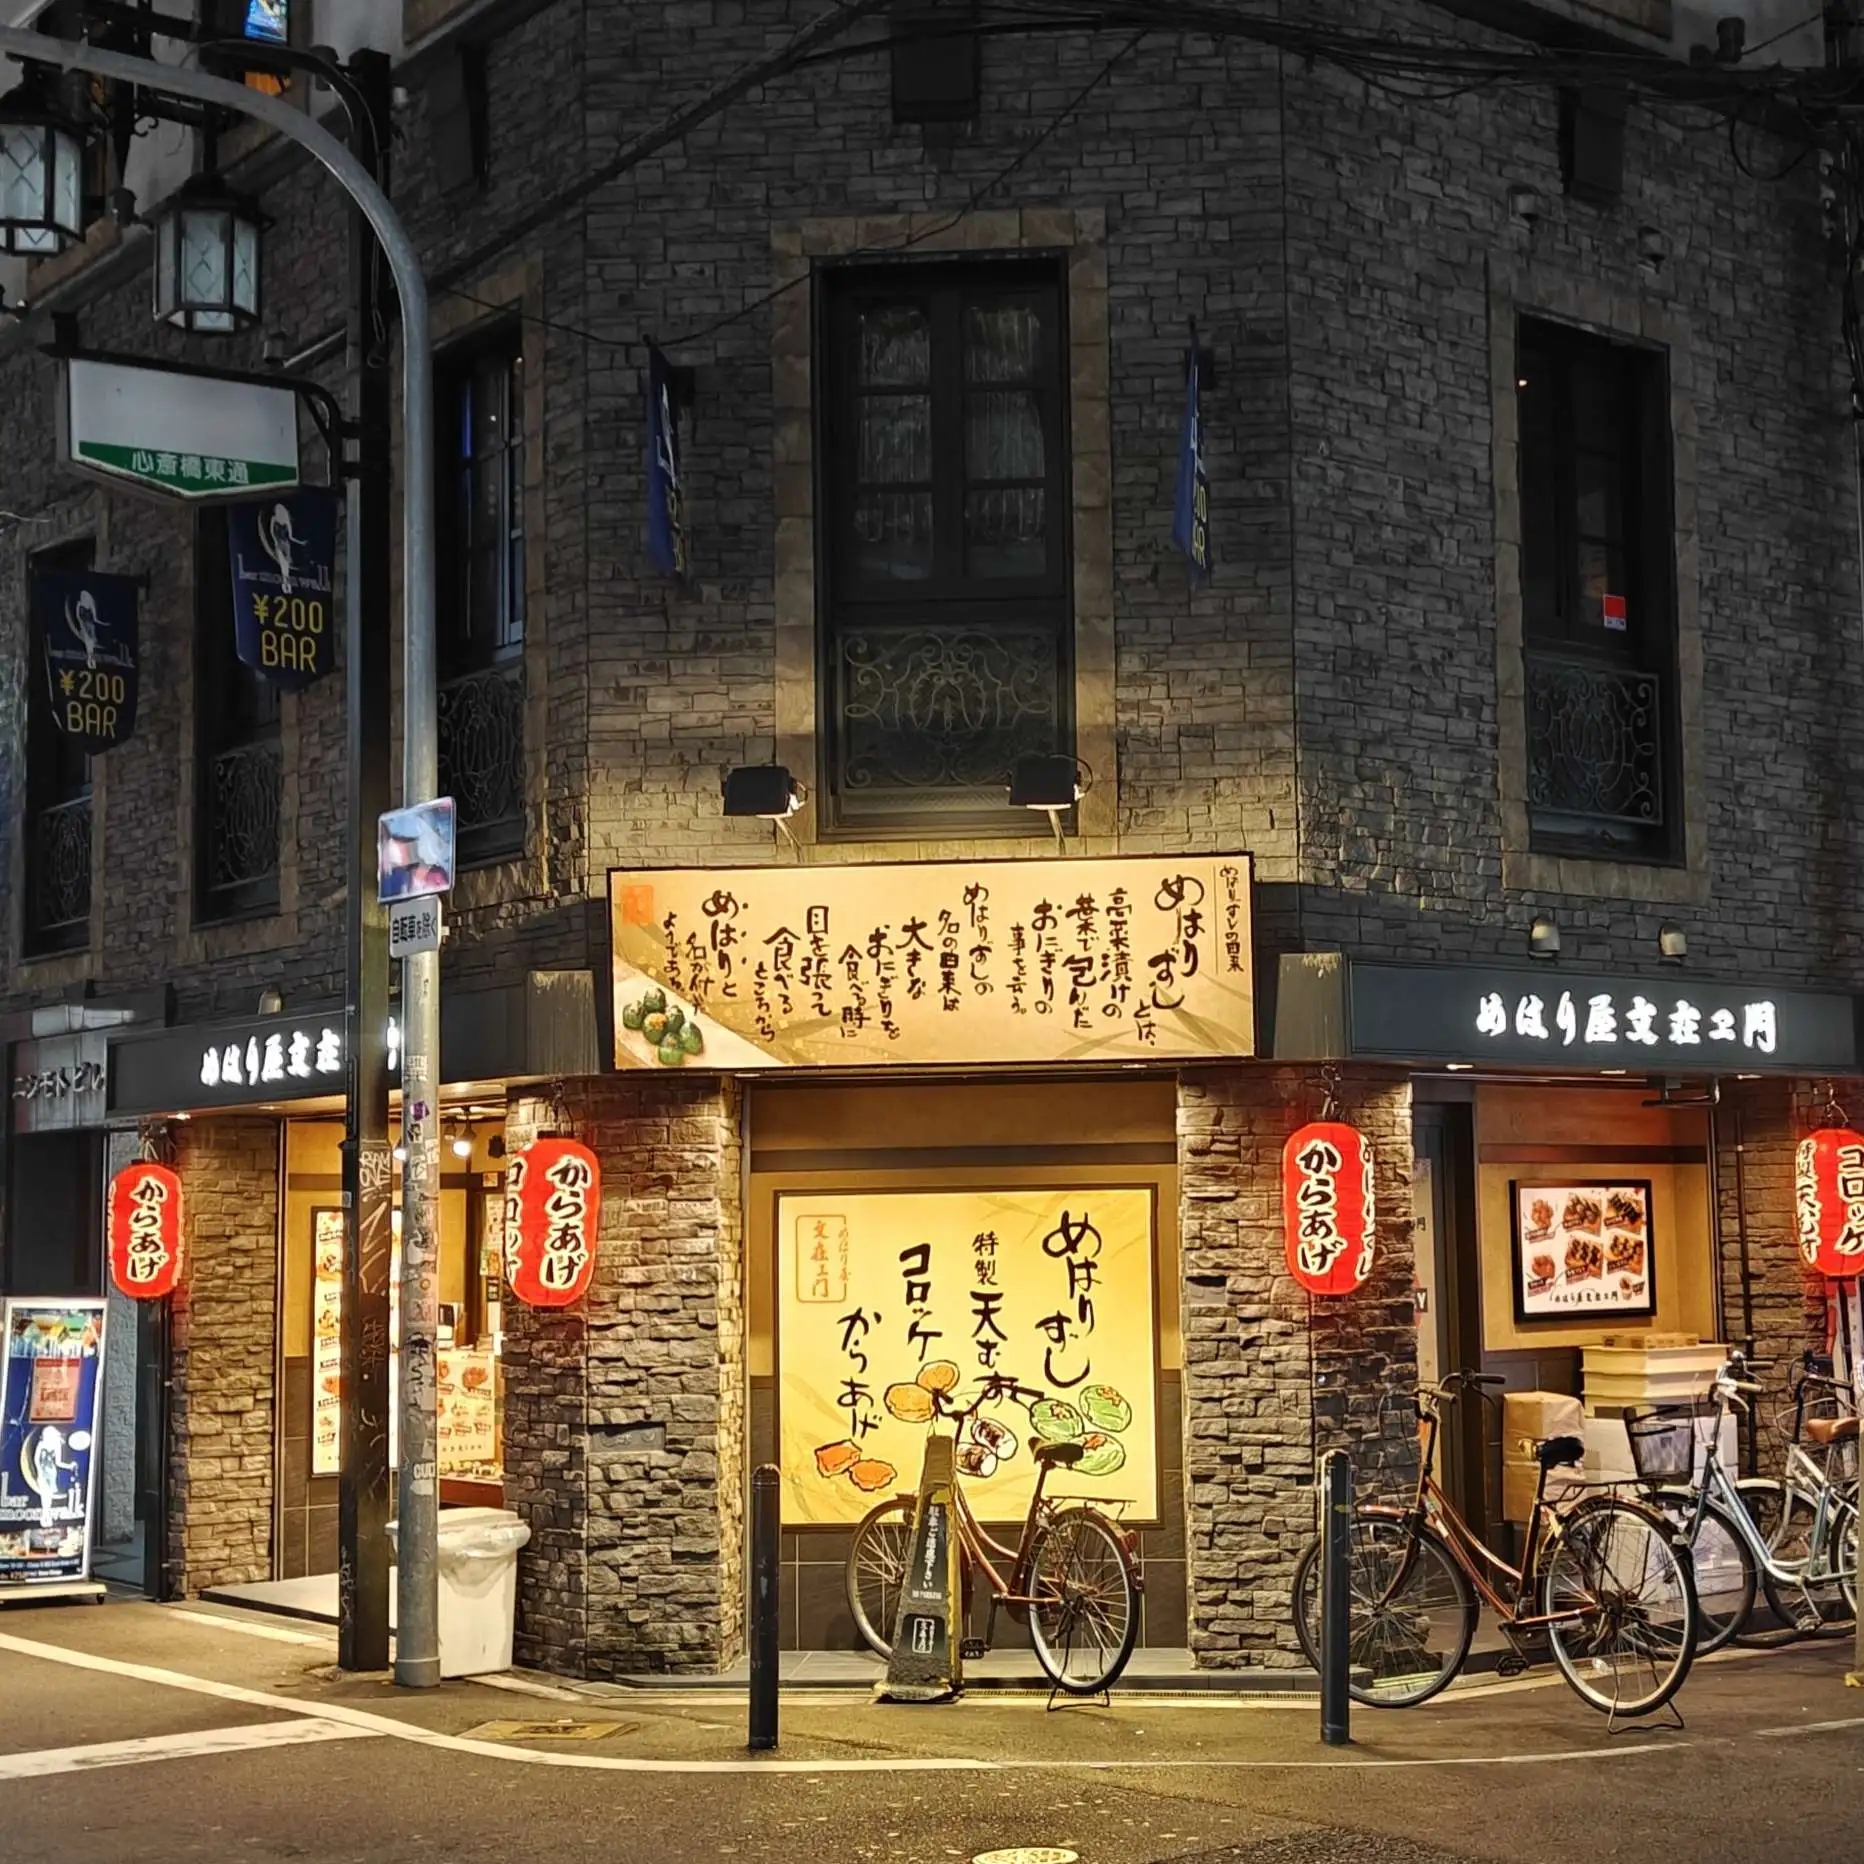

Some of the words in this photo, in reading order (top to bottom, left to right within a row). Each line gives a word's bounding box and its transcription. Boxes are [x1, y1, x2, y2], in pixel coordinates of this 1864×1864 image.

[252, 591, 324, 634] ¥200
[261, 629, 317, 674] BAR
[58, 667, 125, 704] ¥200
[66, 700, 117, 739] BAR
[763, 926, 801, 1015] 食べる
[800, 905, 833, 1017] 目を張って
[838, 943, 872, 1039] 食べる時に
[866, 924, 901, 1041] おにぎりを
[895, 916, 934, 1001] 大きな
[937, 909, 962, 1013] 名の由来は
[1031, 897, 1063, 1015] おにぎりの
[1061, 892, 1100, 1029] 葉で包んだ
[1099, 887, 1133, 1019] 高菜漬けの
[128, 1177, 169, 1282] からあげ
[541, 1156, 593, 1288] からあげ
[1297, 1140, 1347, 1275] からあげ
[899, 1242, 943, 1362] コロッケ
[1034, 1209, 1103, 1389] めはりずし
[836, 1306, 884, 1439] からあげ
